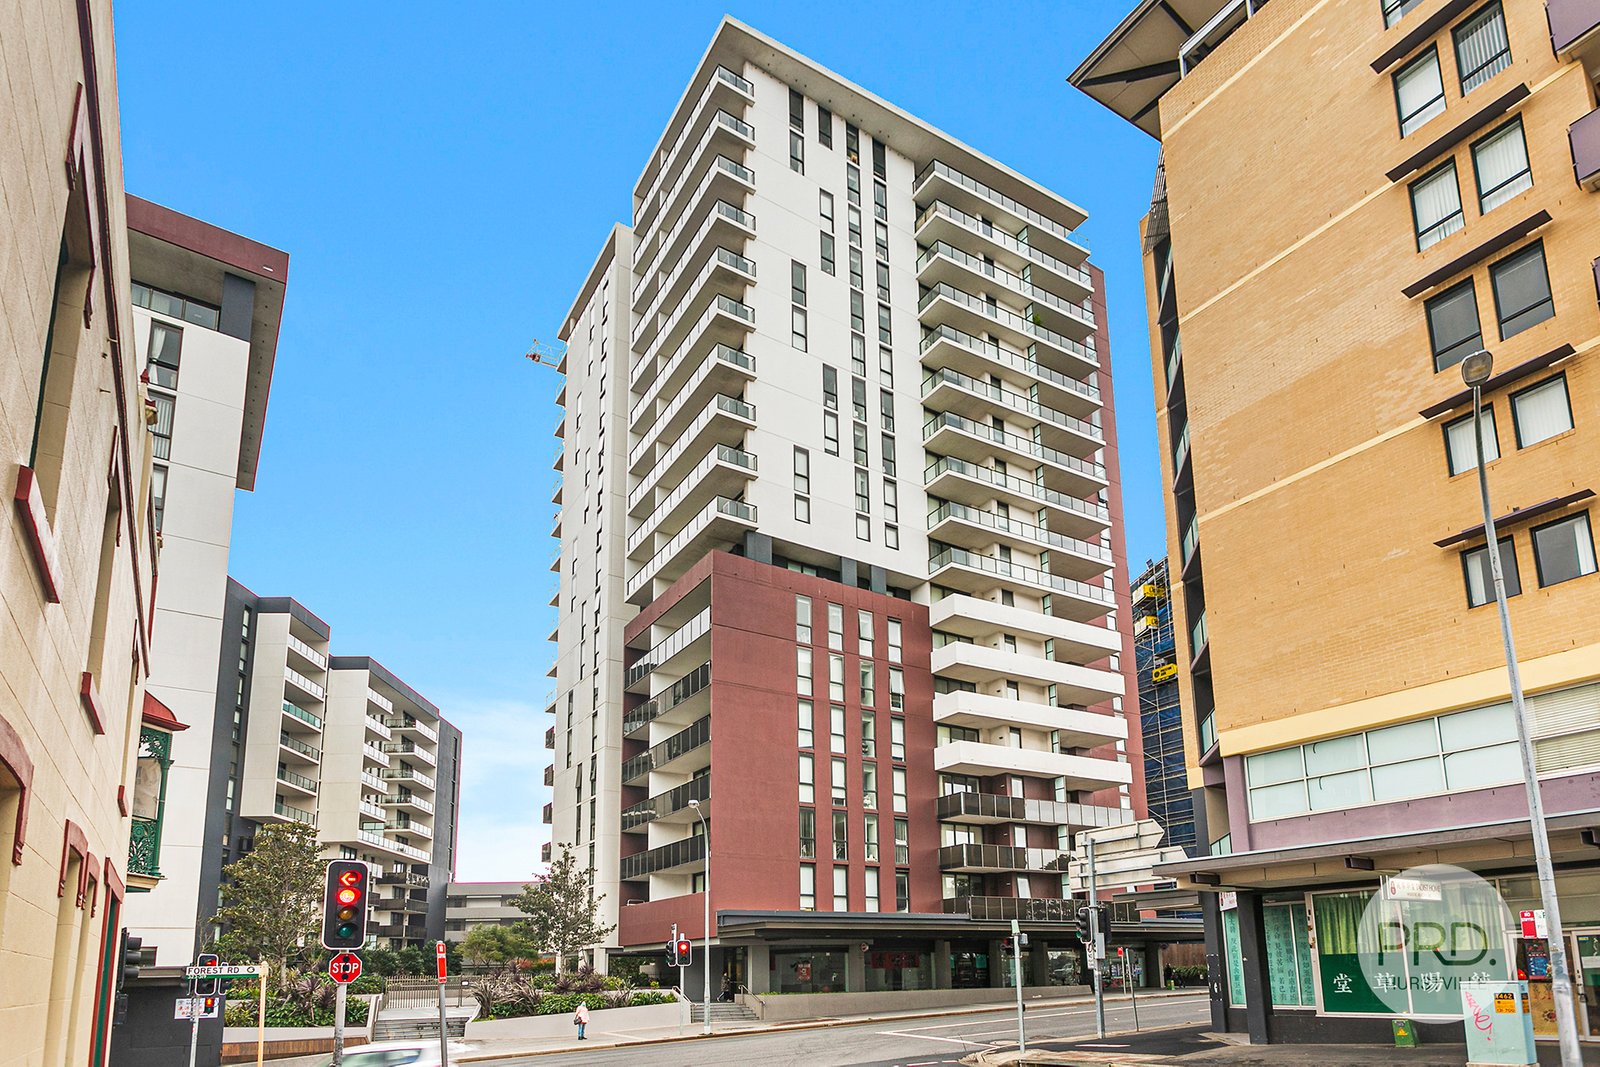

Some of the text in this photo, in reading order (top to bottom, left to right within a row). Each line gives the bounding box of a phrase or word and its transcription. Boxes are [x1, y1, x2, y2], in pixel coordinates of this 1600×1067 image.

[187, 966, 240, 975] FOREST RD
[332, 962, 360, 974] STOP
